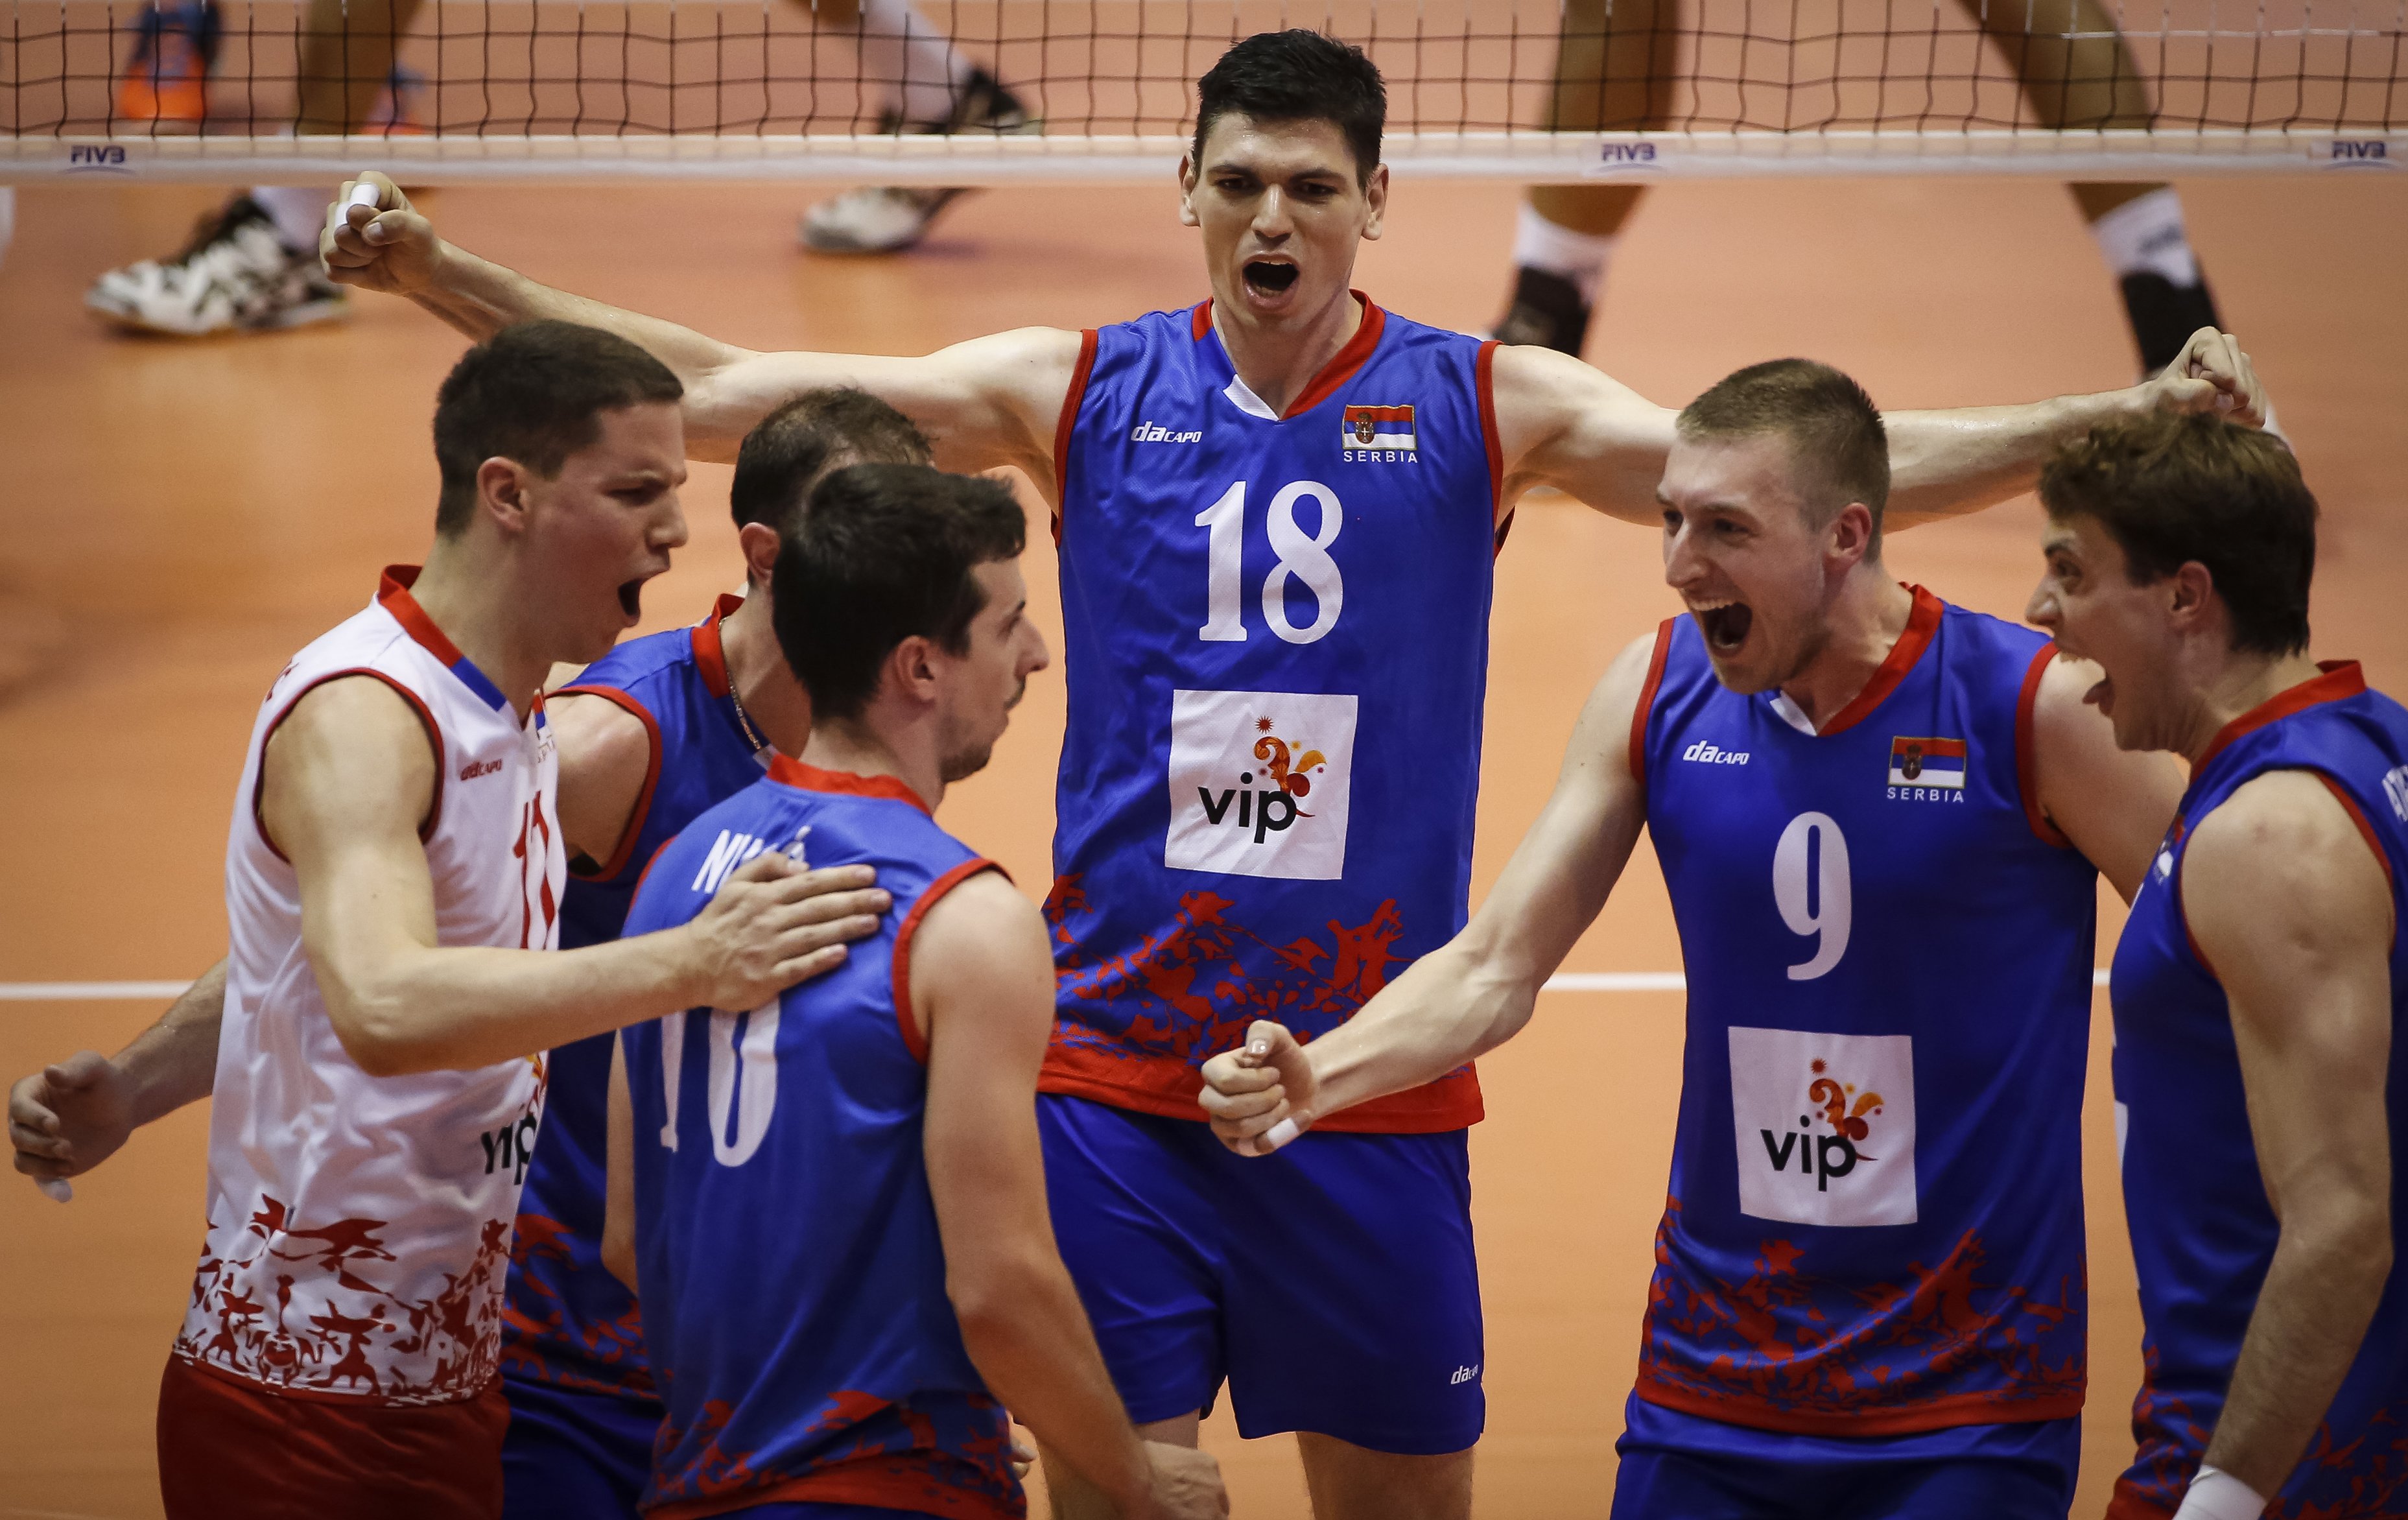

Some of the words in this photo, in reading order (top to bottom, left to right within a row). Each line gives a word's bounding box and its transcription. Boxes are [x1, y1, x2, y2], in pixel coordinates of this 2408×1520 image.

[71, 144, 124, 163] FIVB
[1601, 143, 1655, 161] FIVB
[2332, 140, 2386, 158] FIVB
[1343, 450, 1418, 464] SERBIA
[1194, 480, 1343, 645] 18
[1197, 771, 1297, 844] vip
[1887, 787, 1965, 803] SERBIA
[1772, 811, 1852, 981] 9
[659, 996, 781, 1168] 10
[1760, 1115, 1858, 1193] vip
